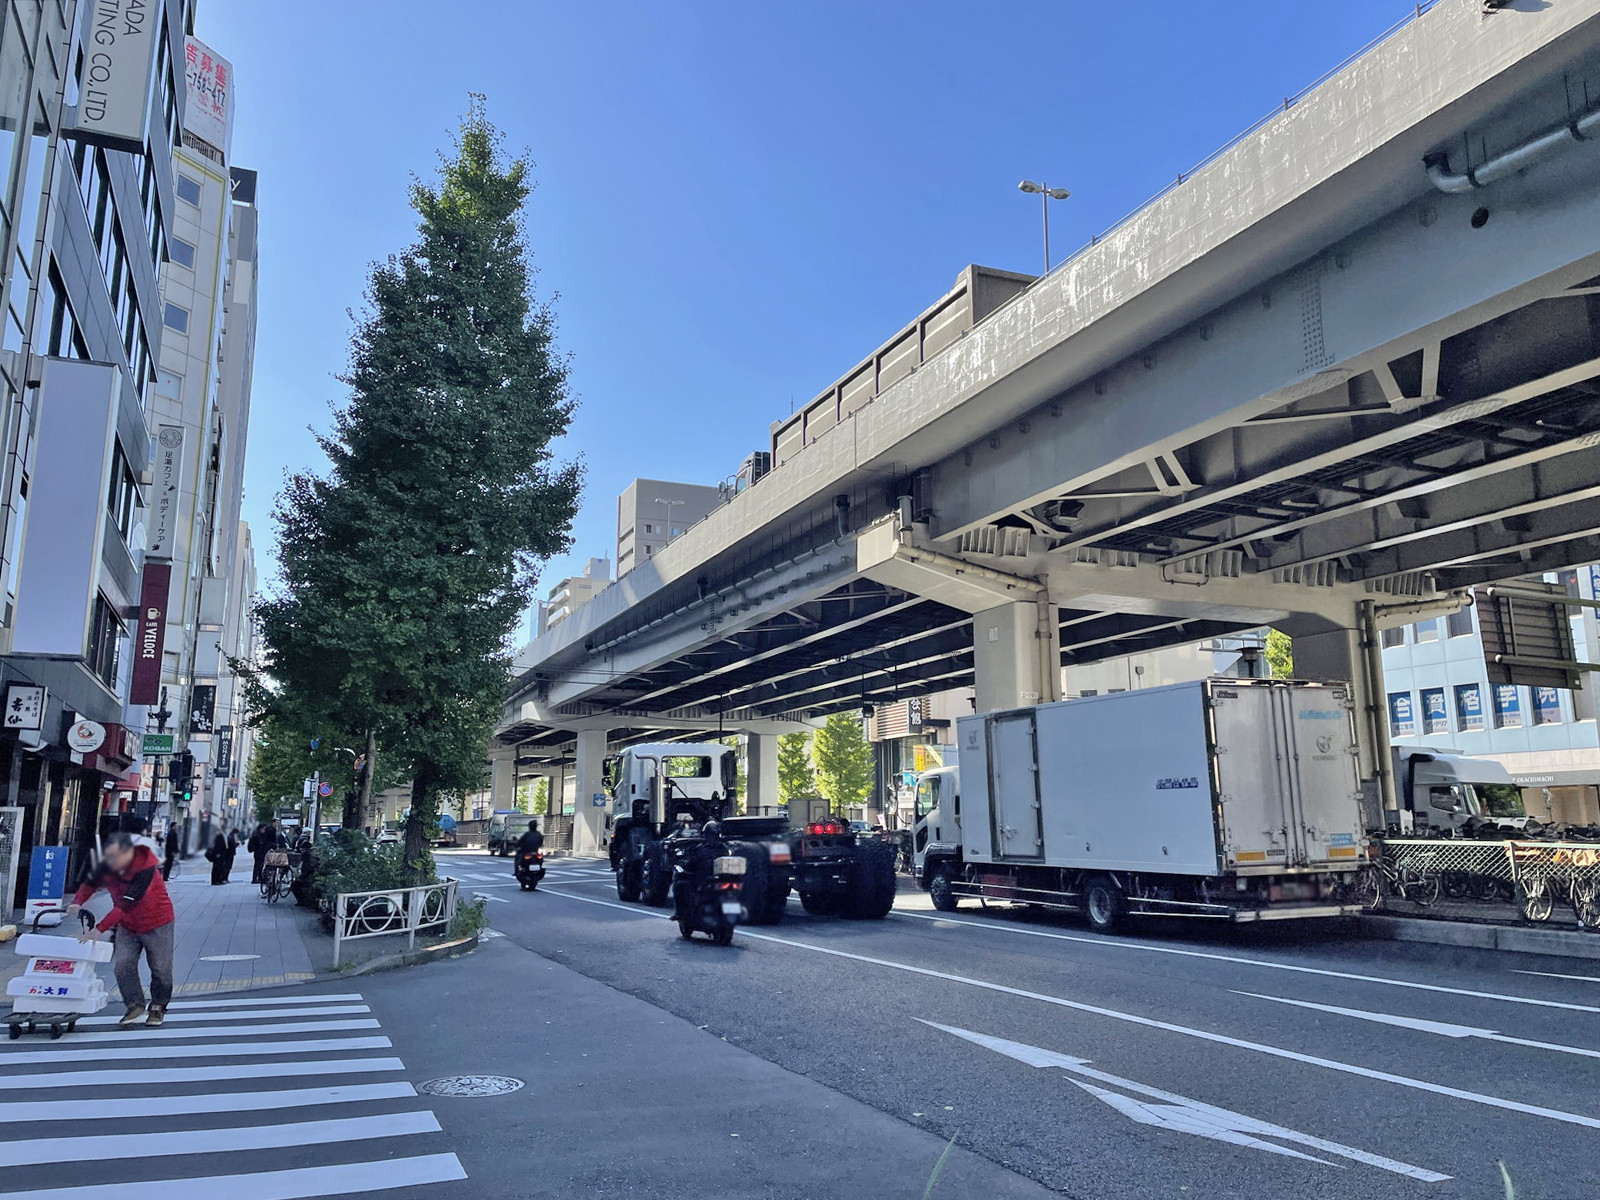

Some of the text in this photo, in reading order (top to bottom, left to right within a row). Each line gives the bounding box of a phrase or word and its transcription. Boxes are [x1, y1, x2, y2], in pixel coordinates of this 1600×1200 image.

[123, 0, 146, 35] ADA
[142, 628, 158, 659] VELOCE
[910, 697, 922, 726] 会館
